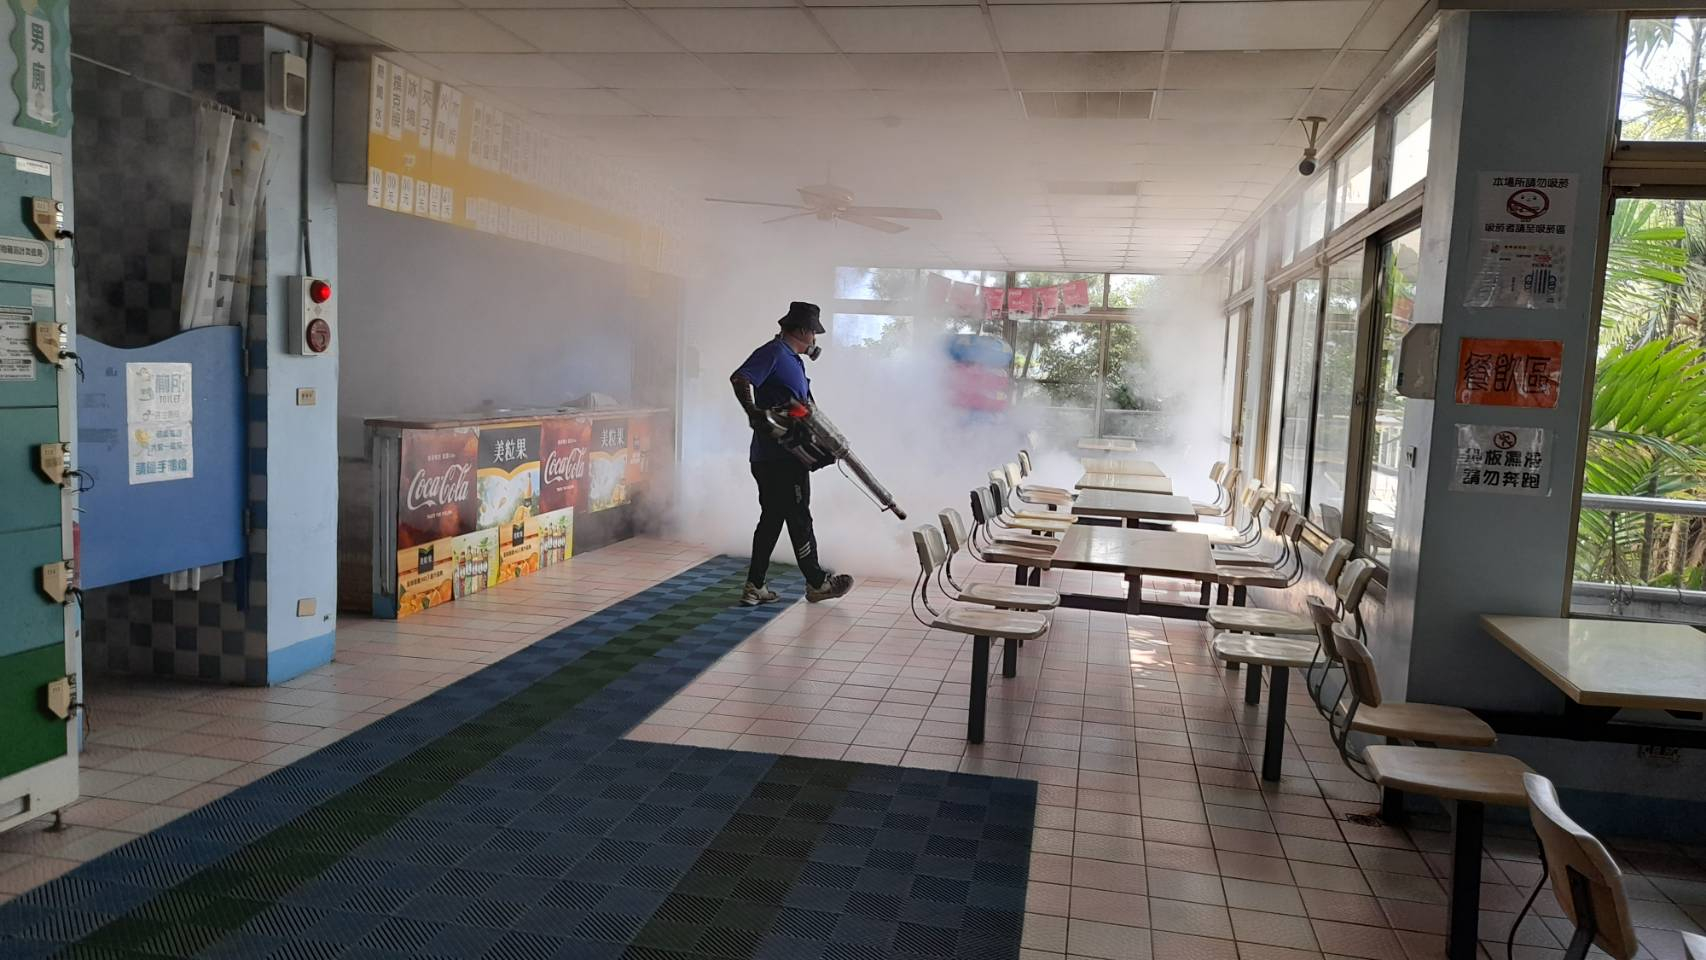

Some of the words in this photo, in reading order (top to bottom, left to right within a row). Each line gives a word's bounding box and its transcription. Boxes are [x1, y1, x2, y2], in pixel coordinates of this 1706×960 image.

[1492, 177, 1569, 189] 本場所請勿吸菸
[1484, 223, 1566, 235] 吸菸者請至吸菸區
[1463, 352, 1559, 394] 餐飲區
[599, 426, 626, 448] 美粒果
[493, 439, 528, 463] 美粒果
[406, 463, 472, 511] Coca-Cola
[1462, 469, 1541, 489] 請勿奔跑
